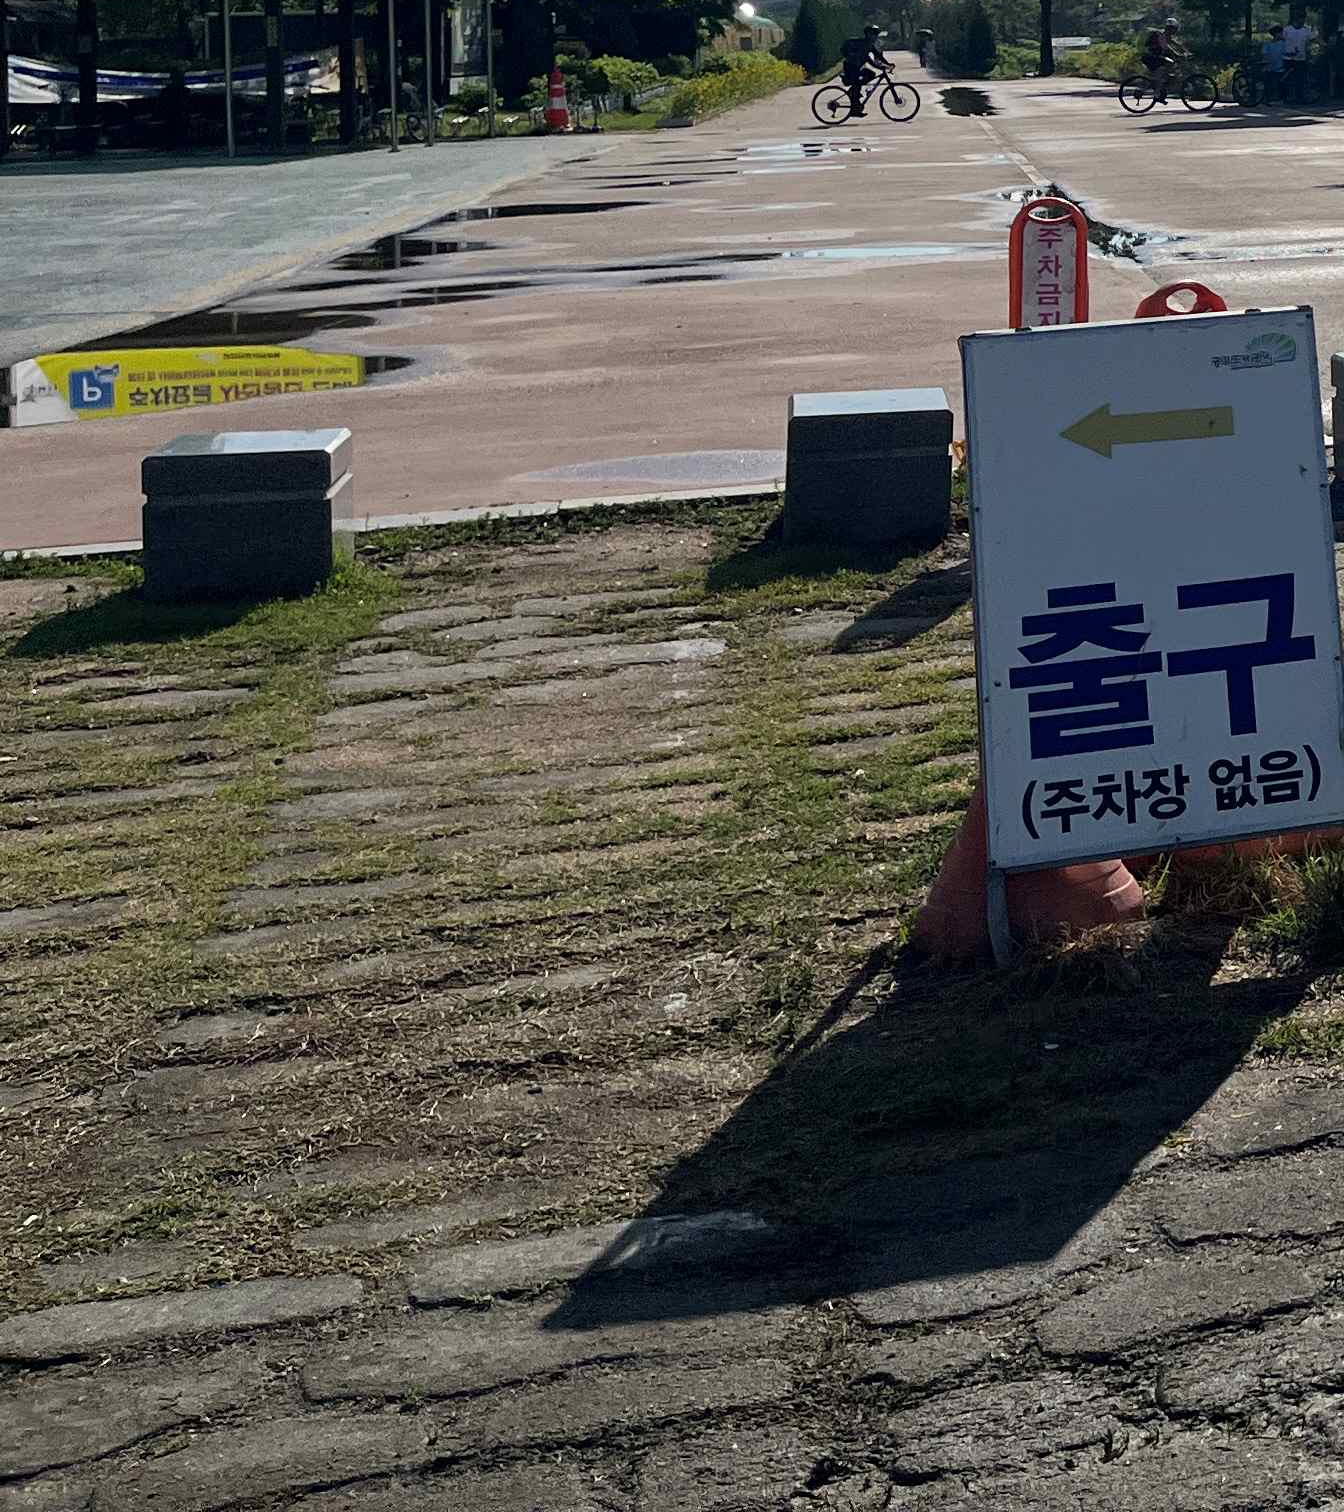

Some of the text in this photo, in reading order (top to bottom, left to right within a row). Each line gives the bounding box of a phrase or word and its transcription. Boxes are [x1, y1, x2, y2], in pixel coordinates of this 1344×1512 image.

[1008, 571, 1317, 761] 출구
[1020, 743, 1322, 840] (주차장 없음)
